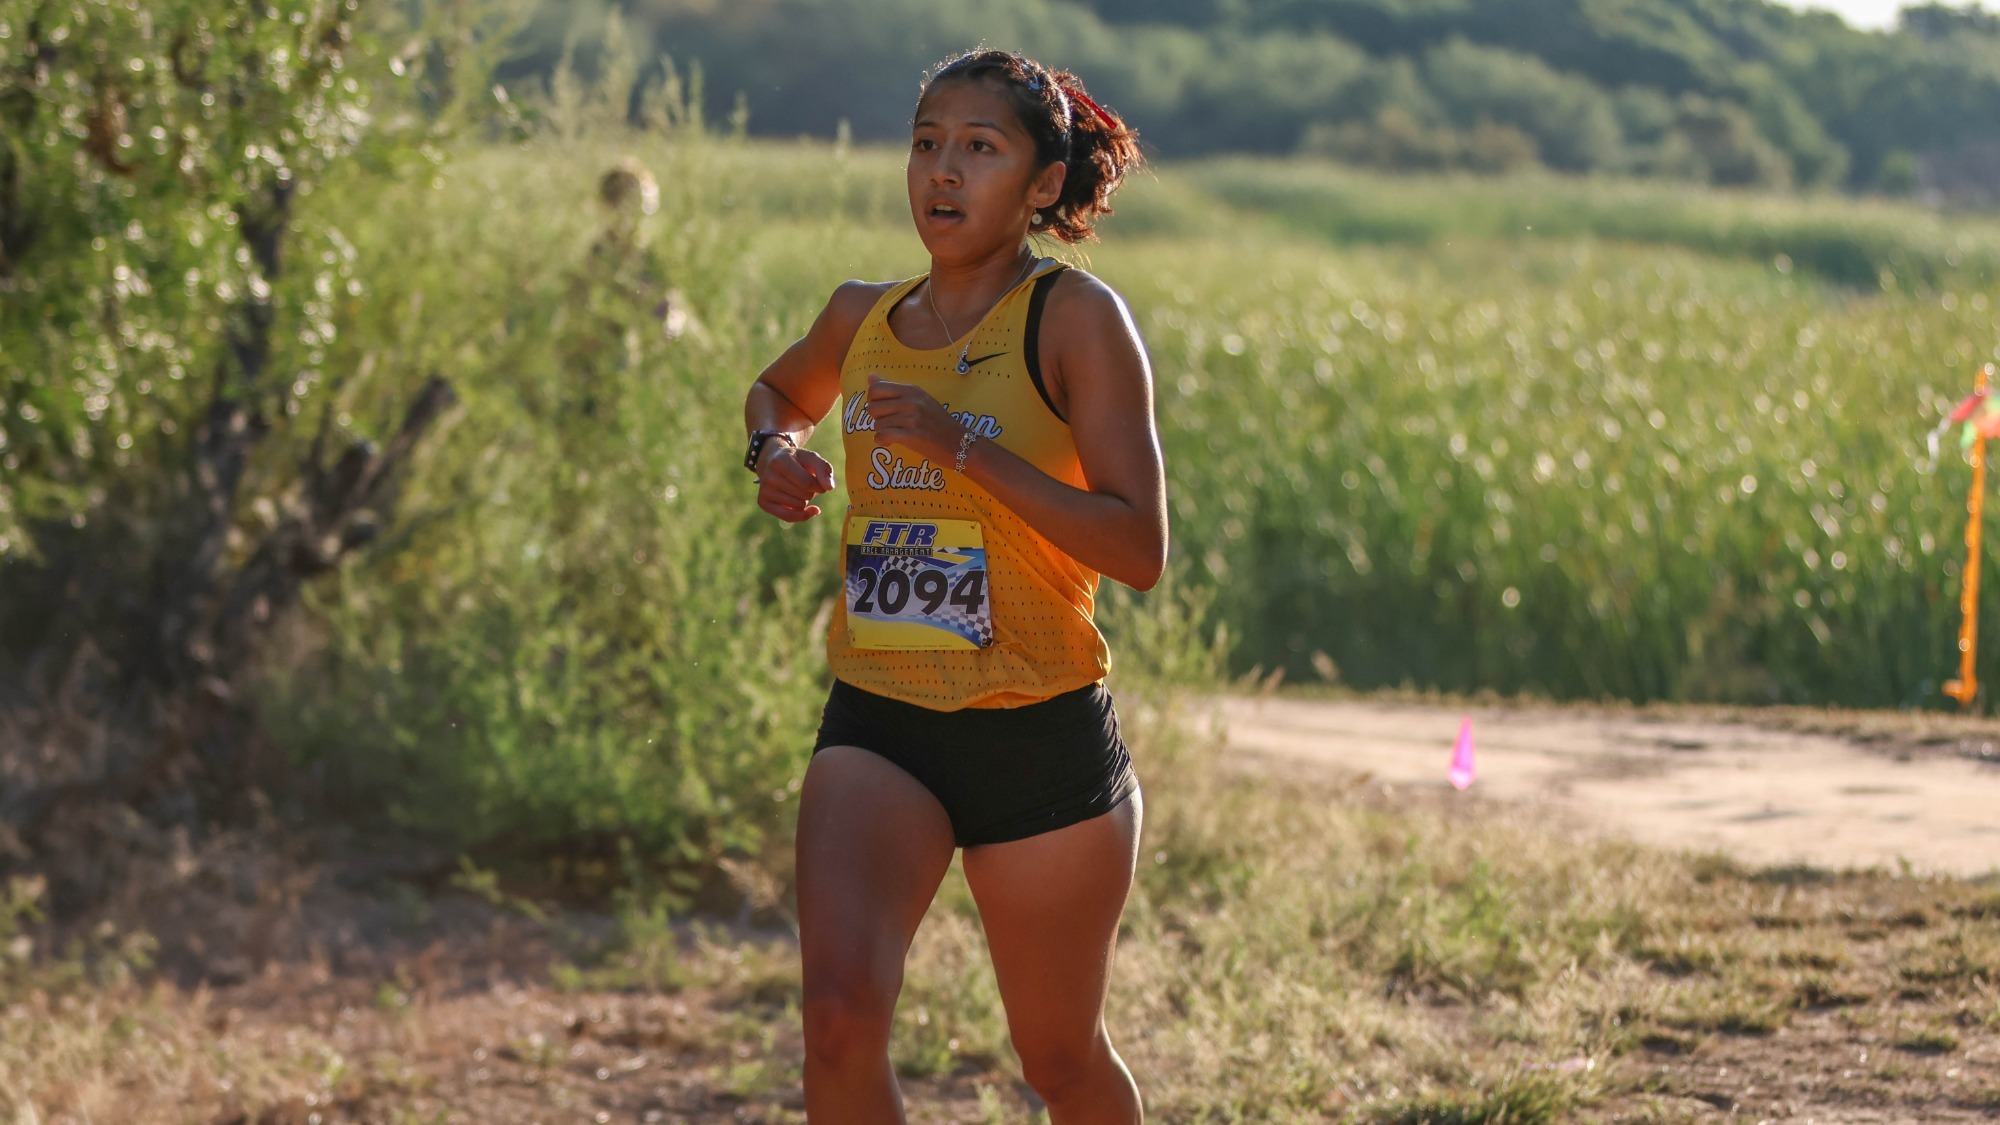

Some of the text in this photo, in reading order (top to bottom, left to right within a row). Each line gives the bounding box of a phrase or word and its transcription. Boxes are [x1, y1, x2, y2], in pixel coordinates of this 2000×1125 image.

[867, 447, 945, 490] State
[861, 521, 938, 547] FTR
[861, 546, 931, 556] RACE MANAGEMENT
[853, 567, 986, 616] 2094
